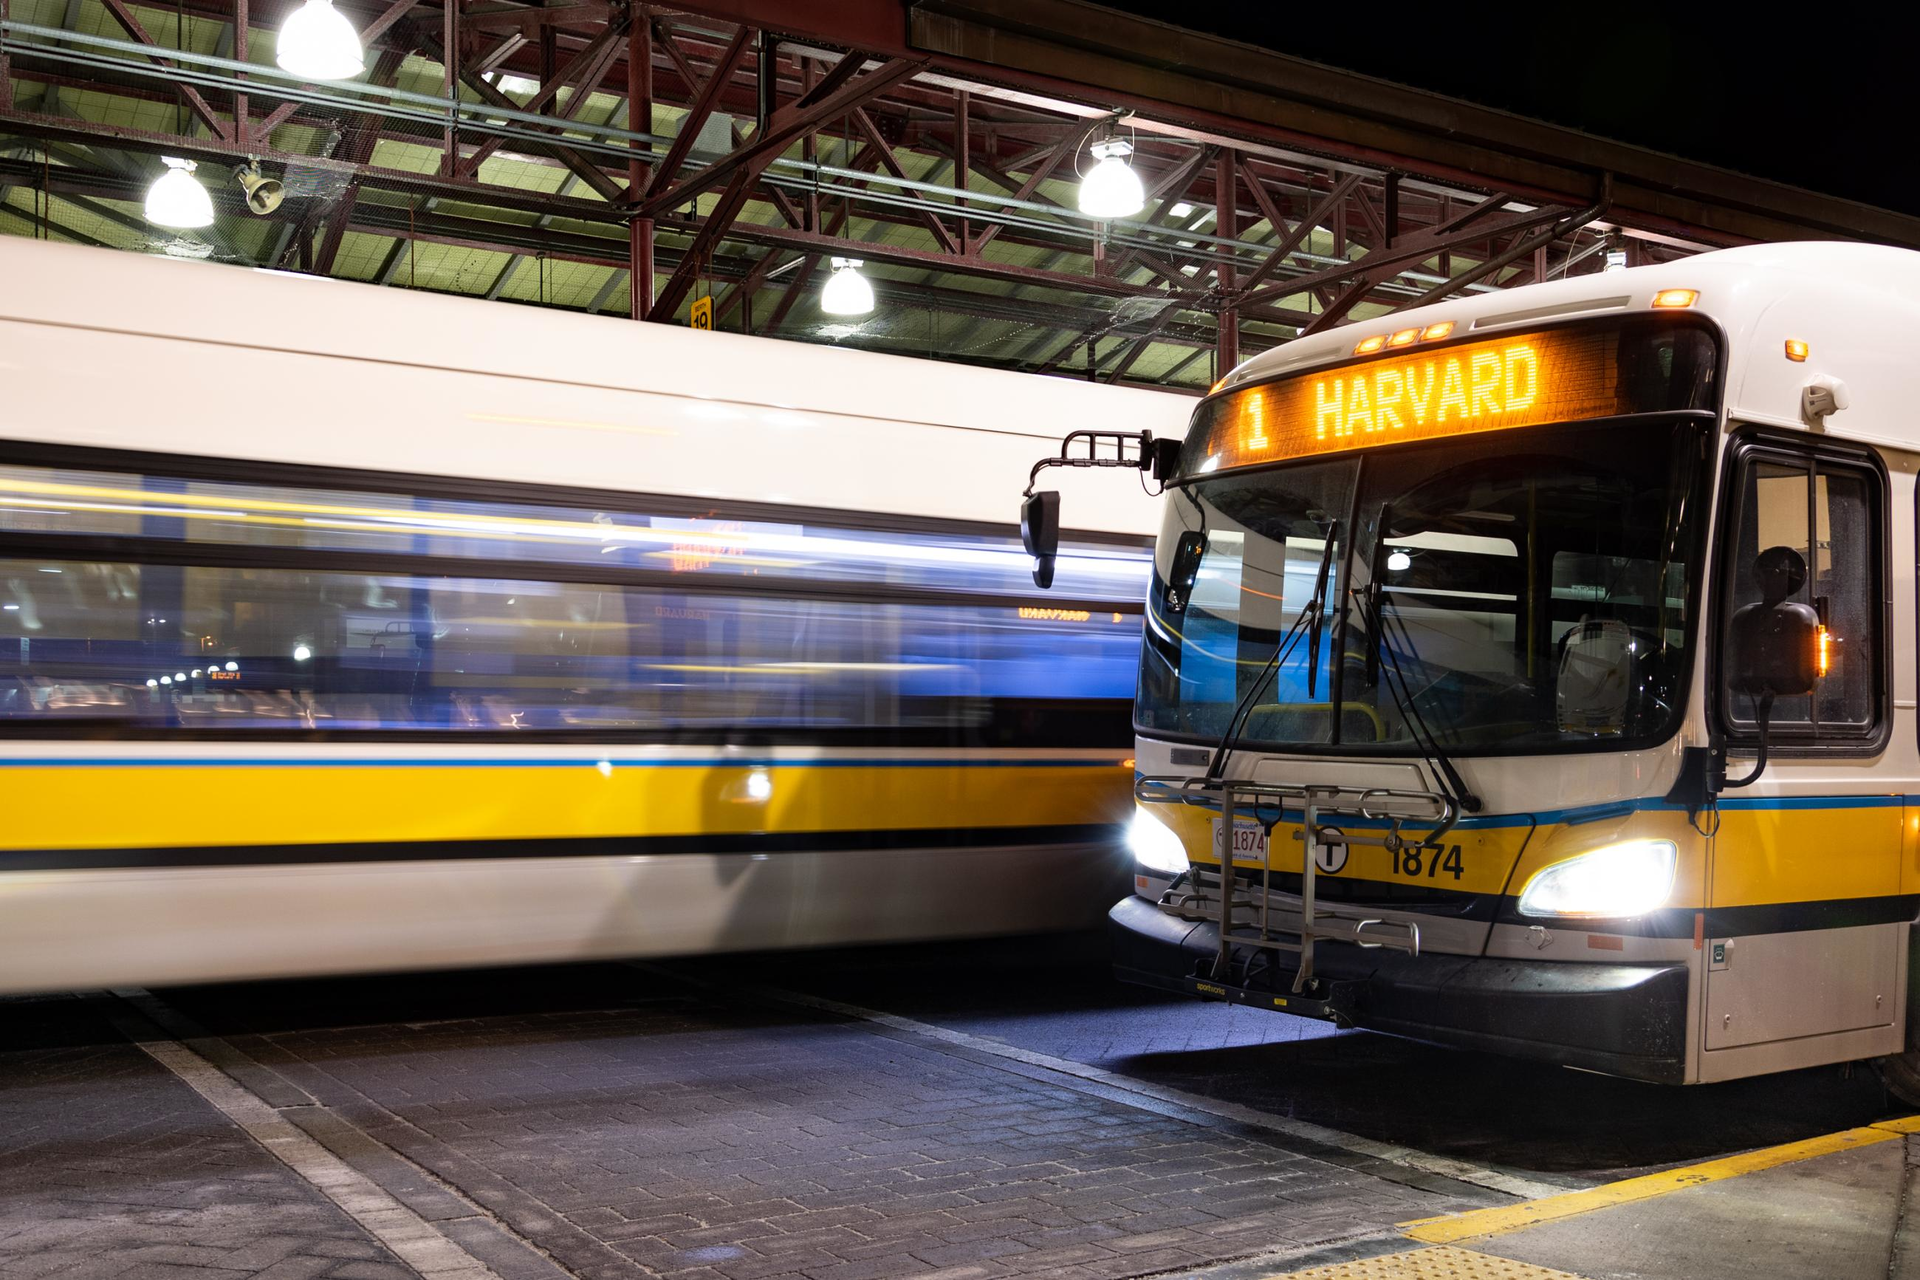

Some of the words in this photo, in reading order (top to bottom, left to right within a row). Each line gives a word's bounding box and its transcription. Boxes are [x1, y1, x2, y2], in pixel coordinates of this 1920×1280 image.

[693, 311, 708, 329] 19
[1248, 392, 1269, 450] 1
[1316, 345, 1538, 441] HARVARD
[1233, 829, 1265, 853] 1874
[1317, 841, 1342, 867] T
[1392, 843, 1465, 881] 1874
